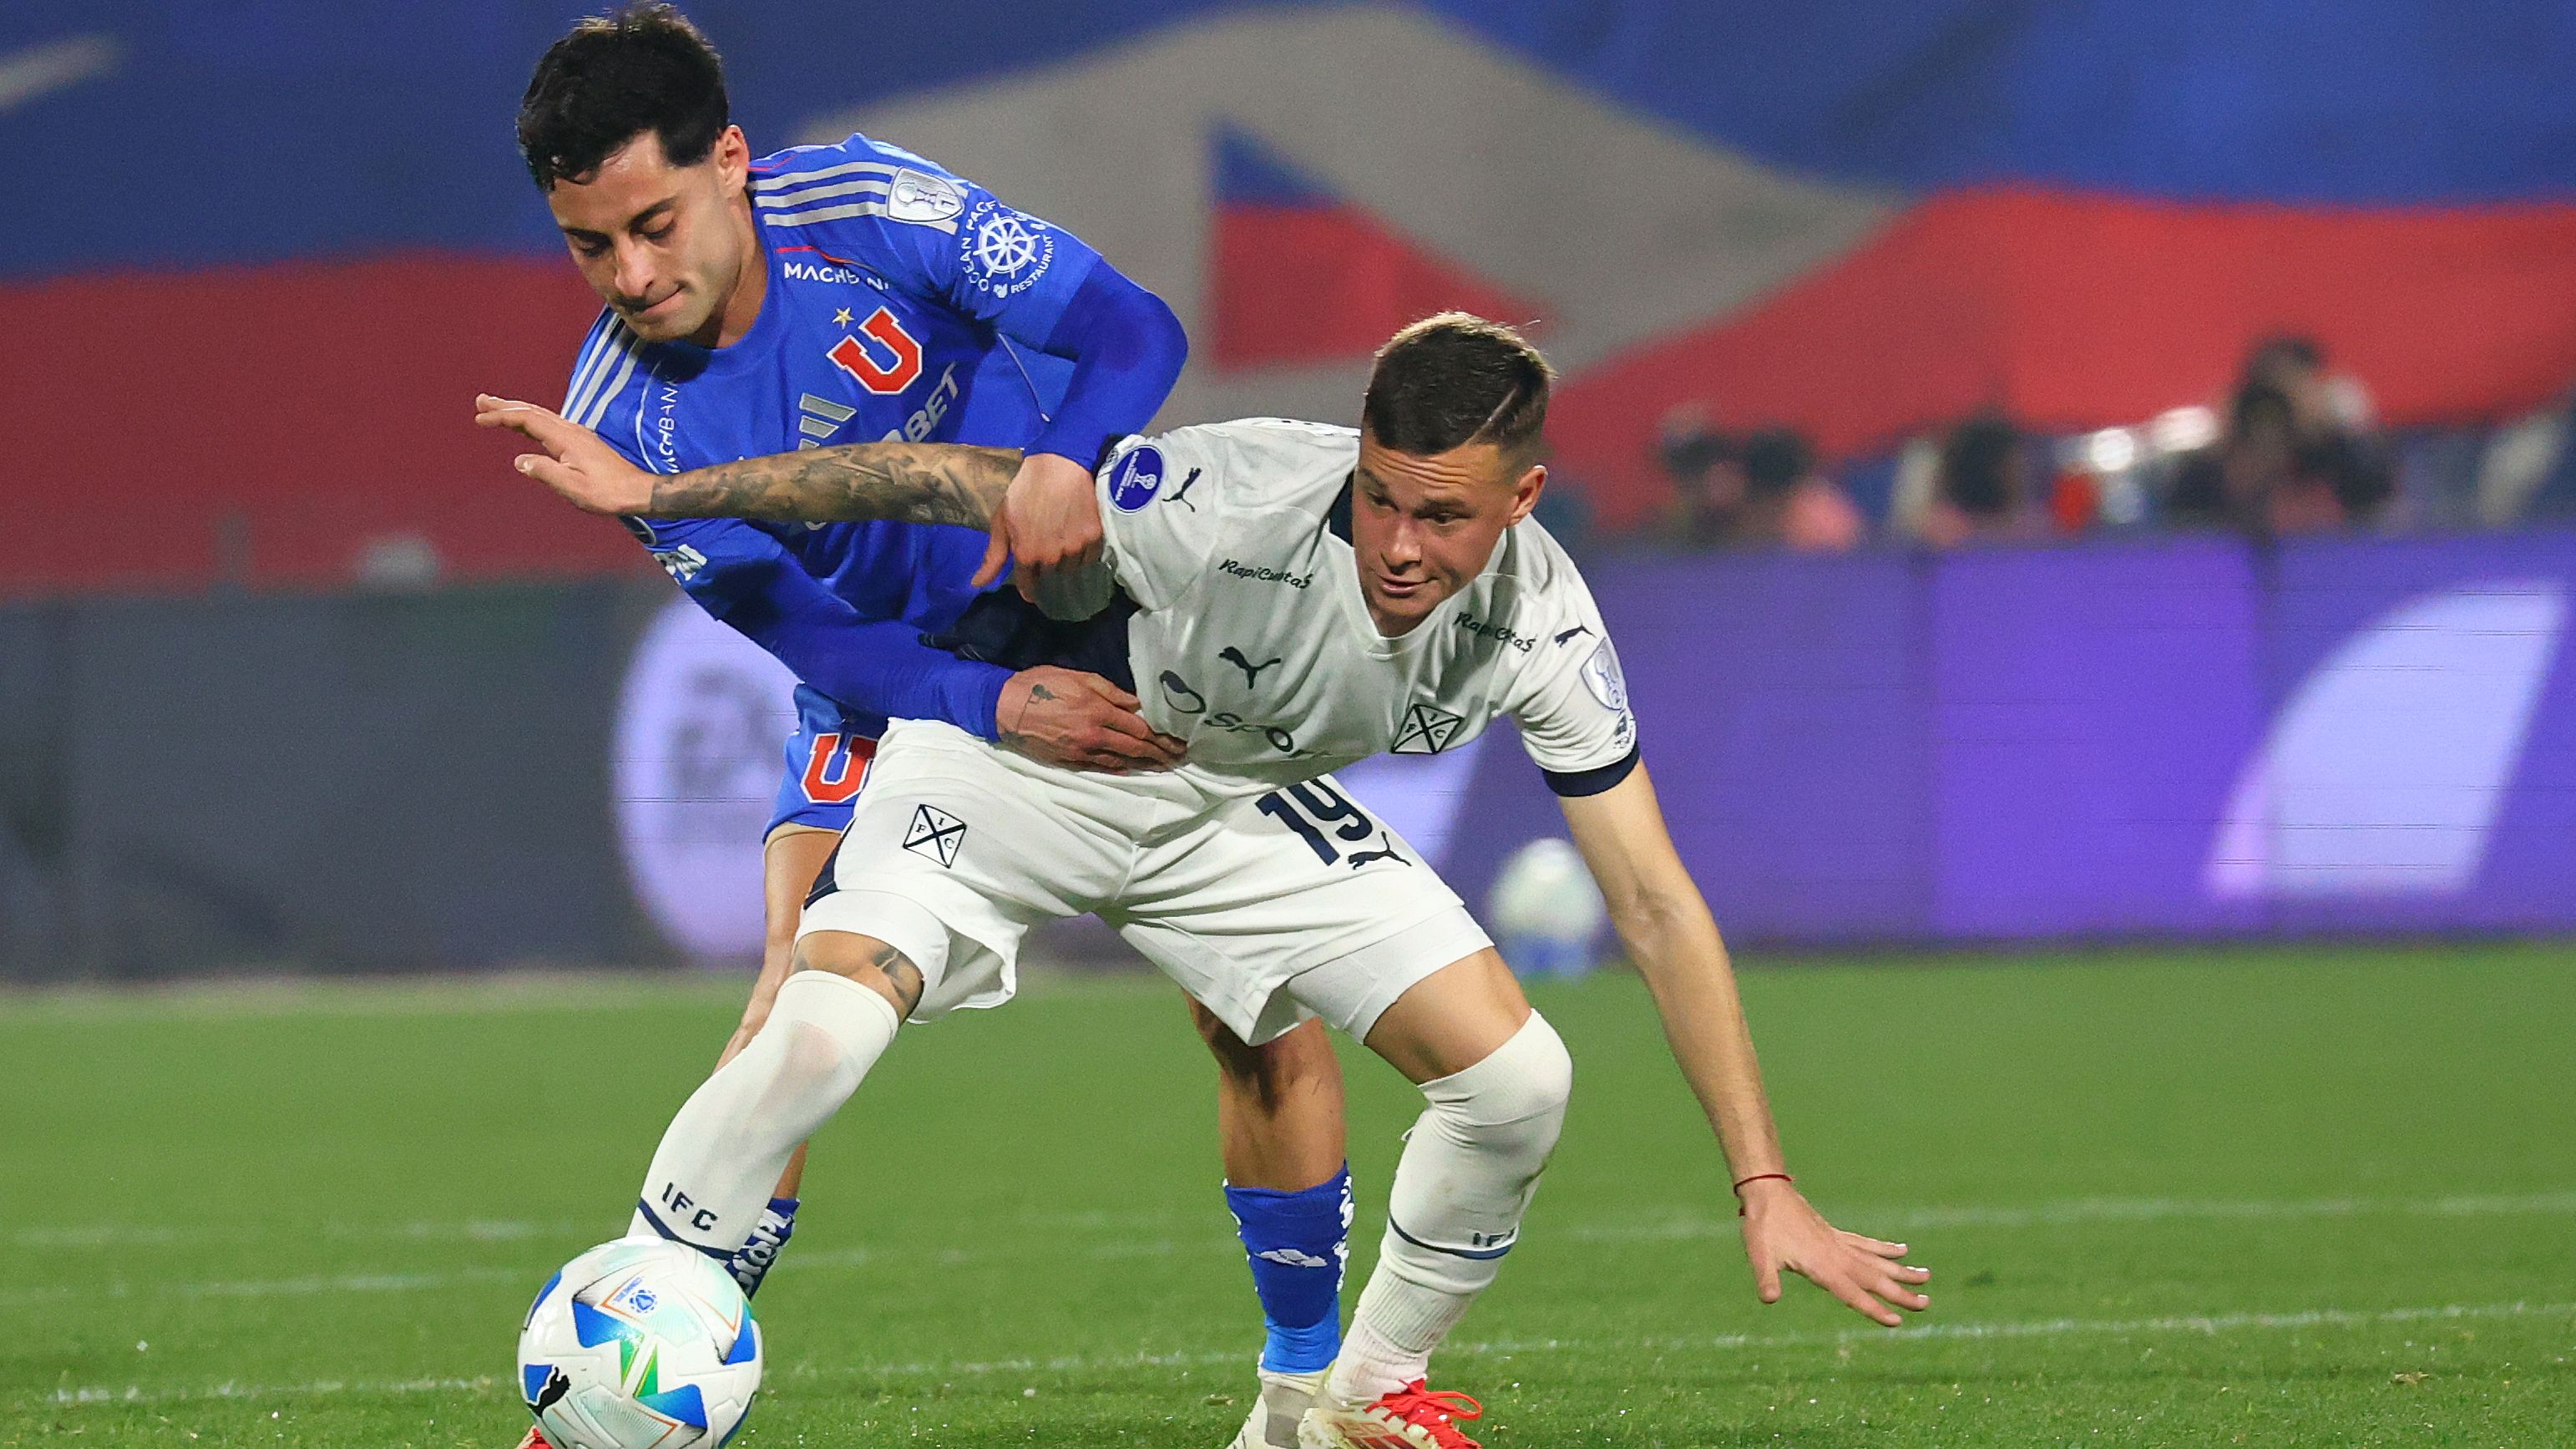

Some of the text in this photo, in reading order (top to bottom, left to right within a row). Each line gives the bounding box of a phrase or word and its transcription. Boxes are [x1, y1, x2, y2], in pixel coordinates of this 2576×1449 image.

[960, 237, 989, 292] OCEAN
[1010, 235, 1055, 294] RESTAURANT
[827, 306, 923, 395] U
[1254, 778, 1373, 867] 19
[662, 1182, 719, 1231] IFC
